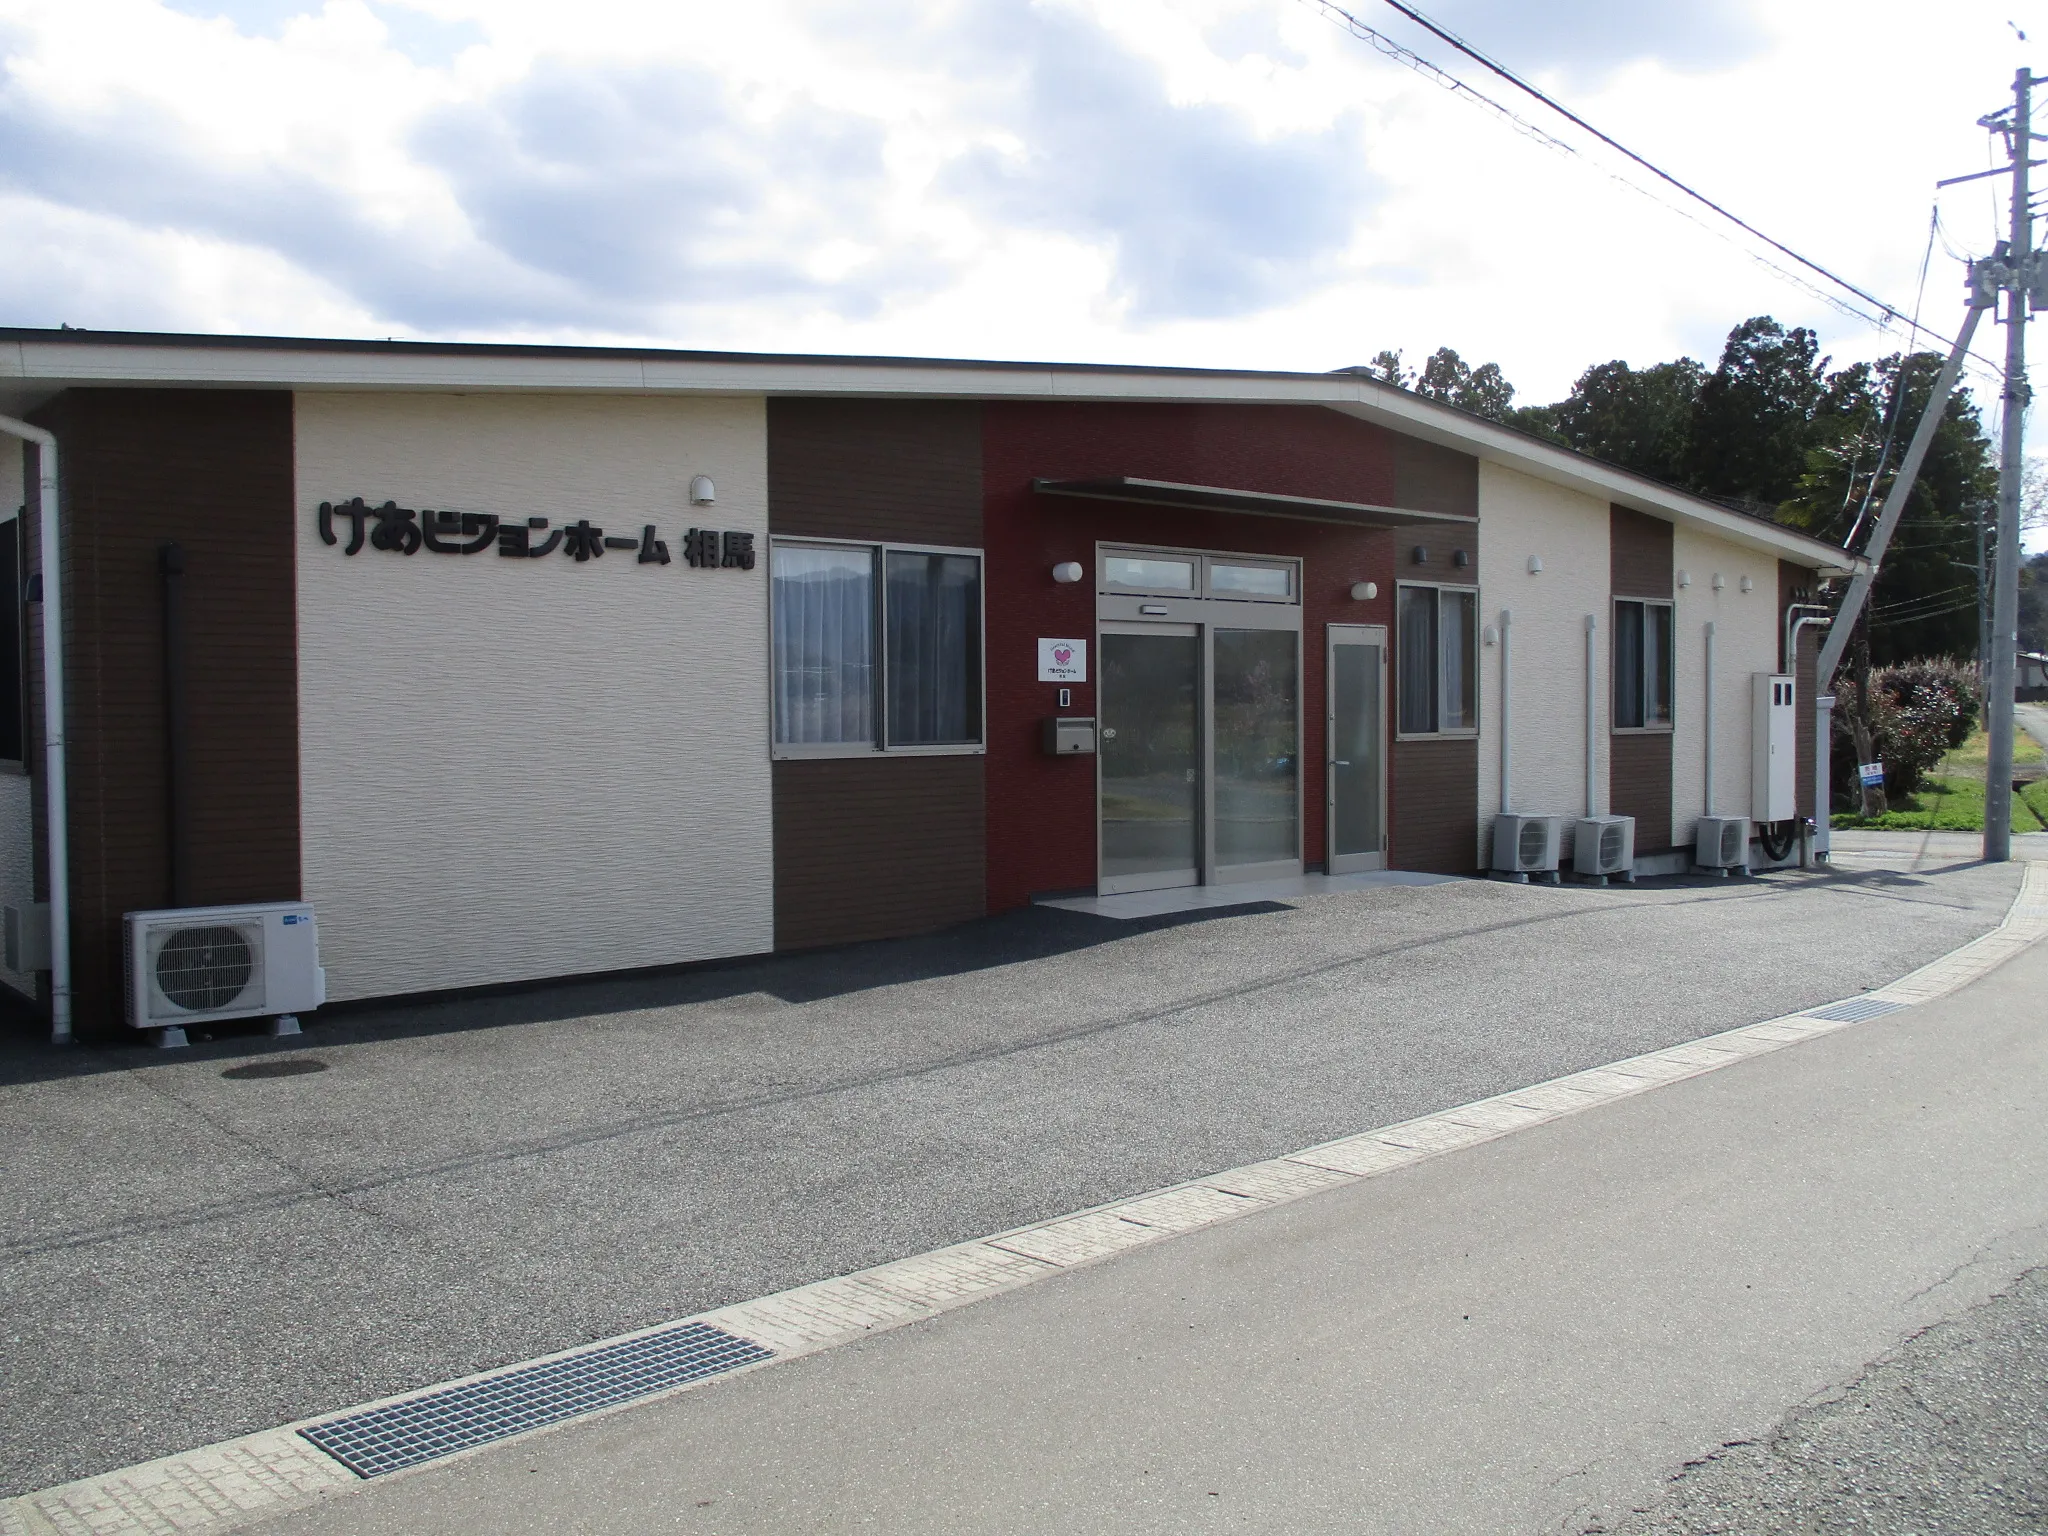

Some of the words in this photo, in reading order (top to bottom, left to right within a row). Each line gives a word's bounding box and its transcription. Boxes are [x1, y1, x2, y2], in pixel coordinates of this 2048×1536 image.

[319, 496, 671, 565] けあビジョンホーム
[683, 528, 755, 570] 相馬
